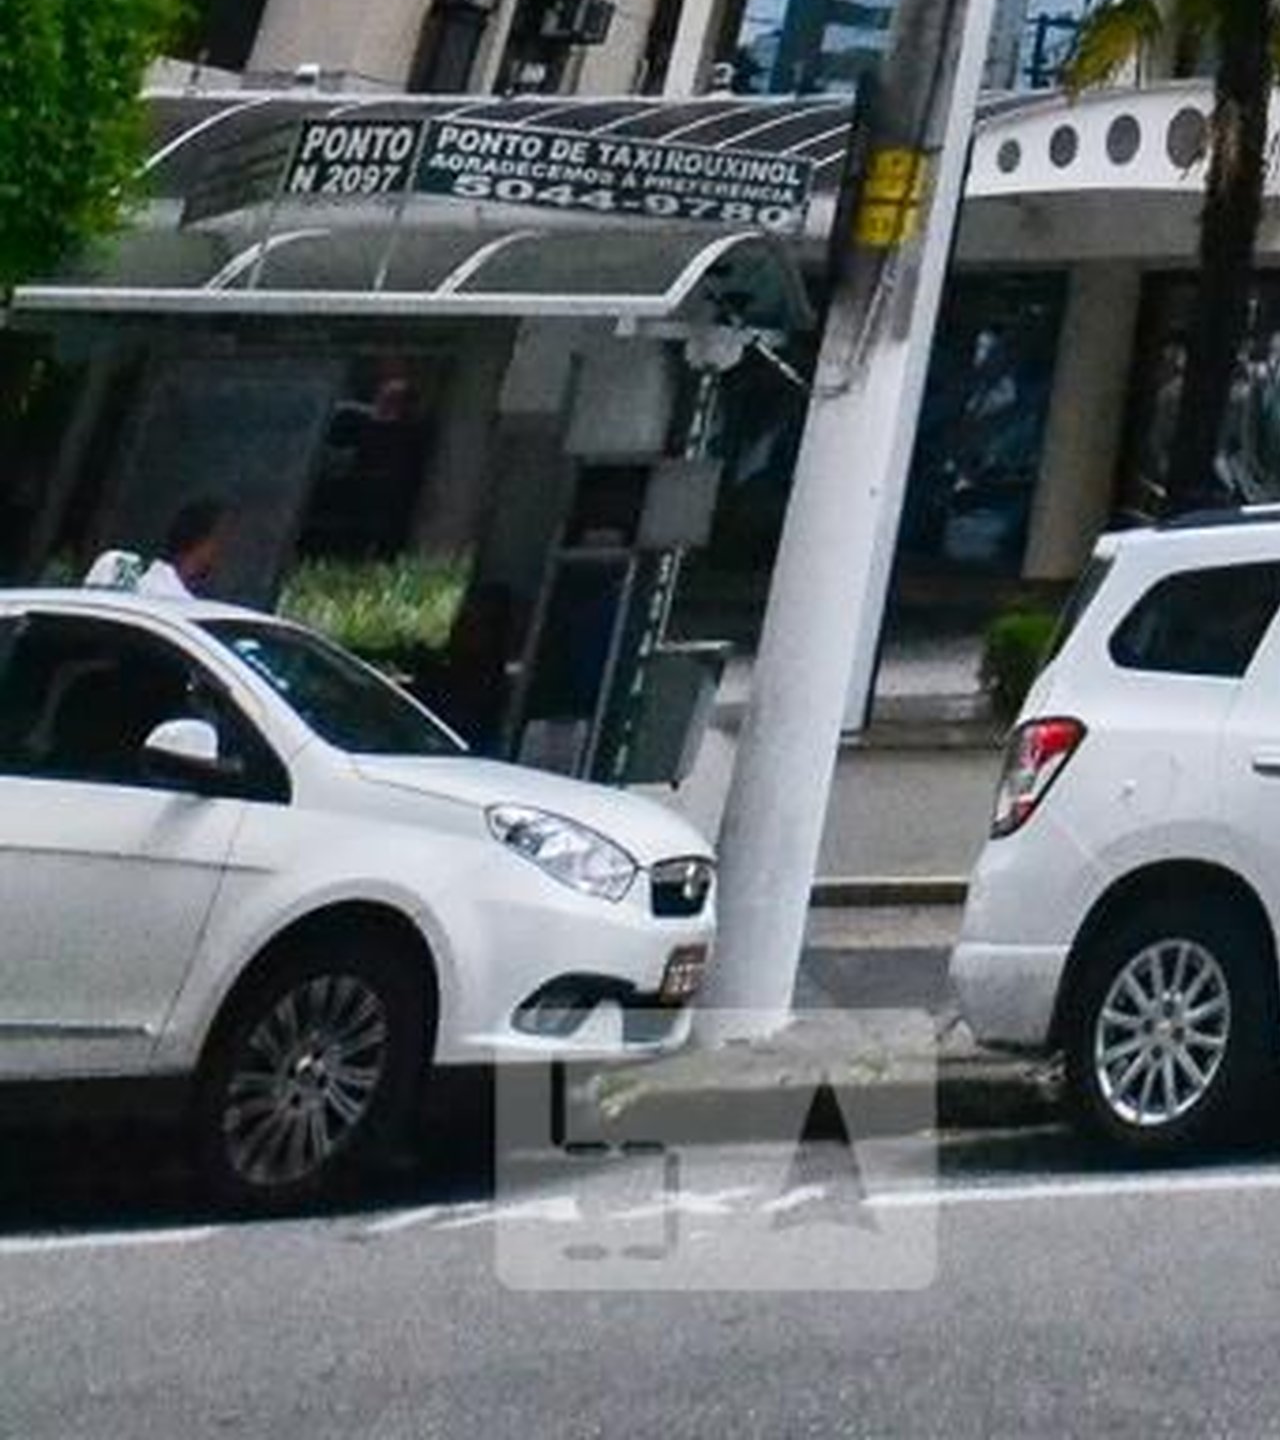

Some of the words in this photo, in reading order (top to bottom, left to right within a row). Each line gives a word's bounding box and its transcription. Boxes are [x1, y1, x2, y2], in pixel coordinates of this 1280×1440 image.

[302, 125, 415, 162] PONTO
[437, 126, 543, 159] PONTO
[549, 138, 590, 164] DE
[598, 143, 663, 171] TAXI
[321, 163, 401, 194] 2097
[452, 174, 793, 231] 5044-9780
